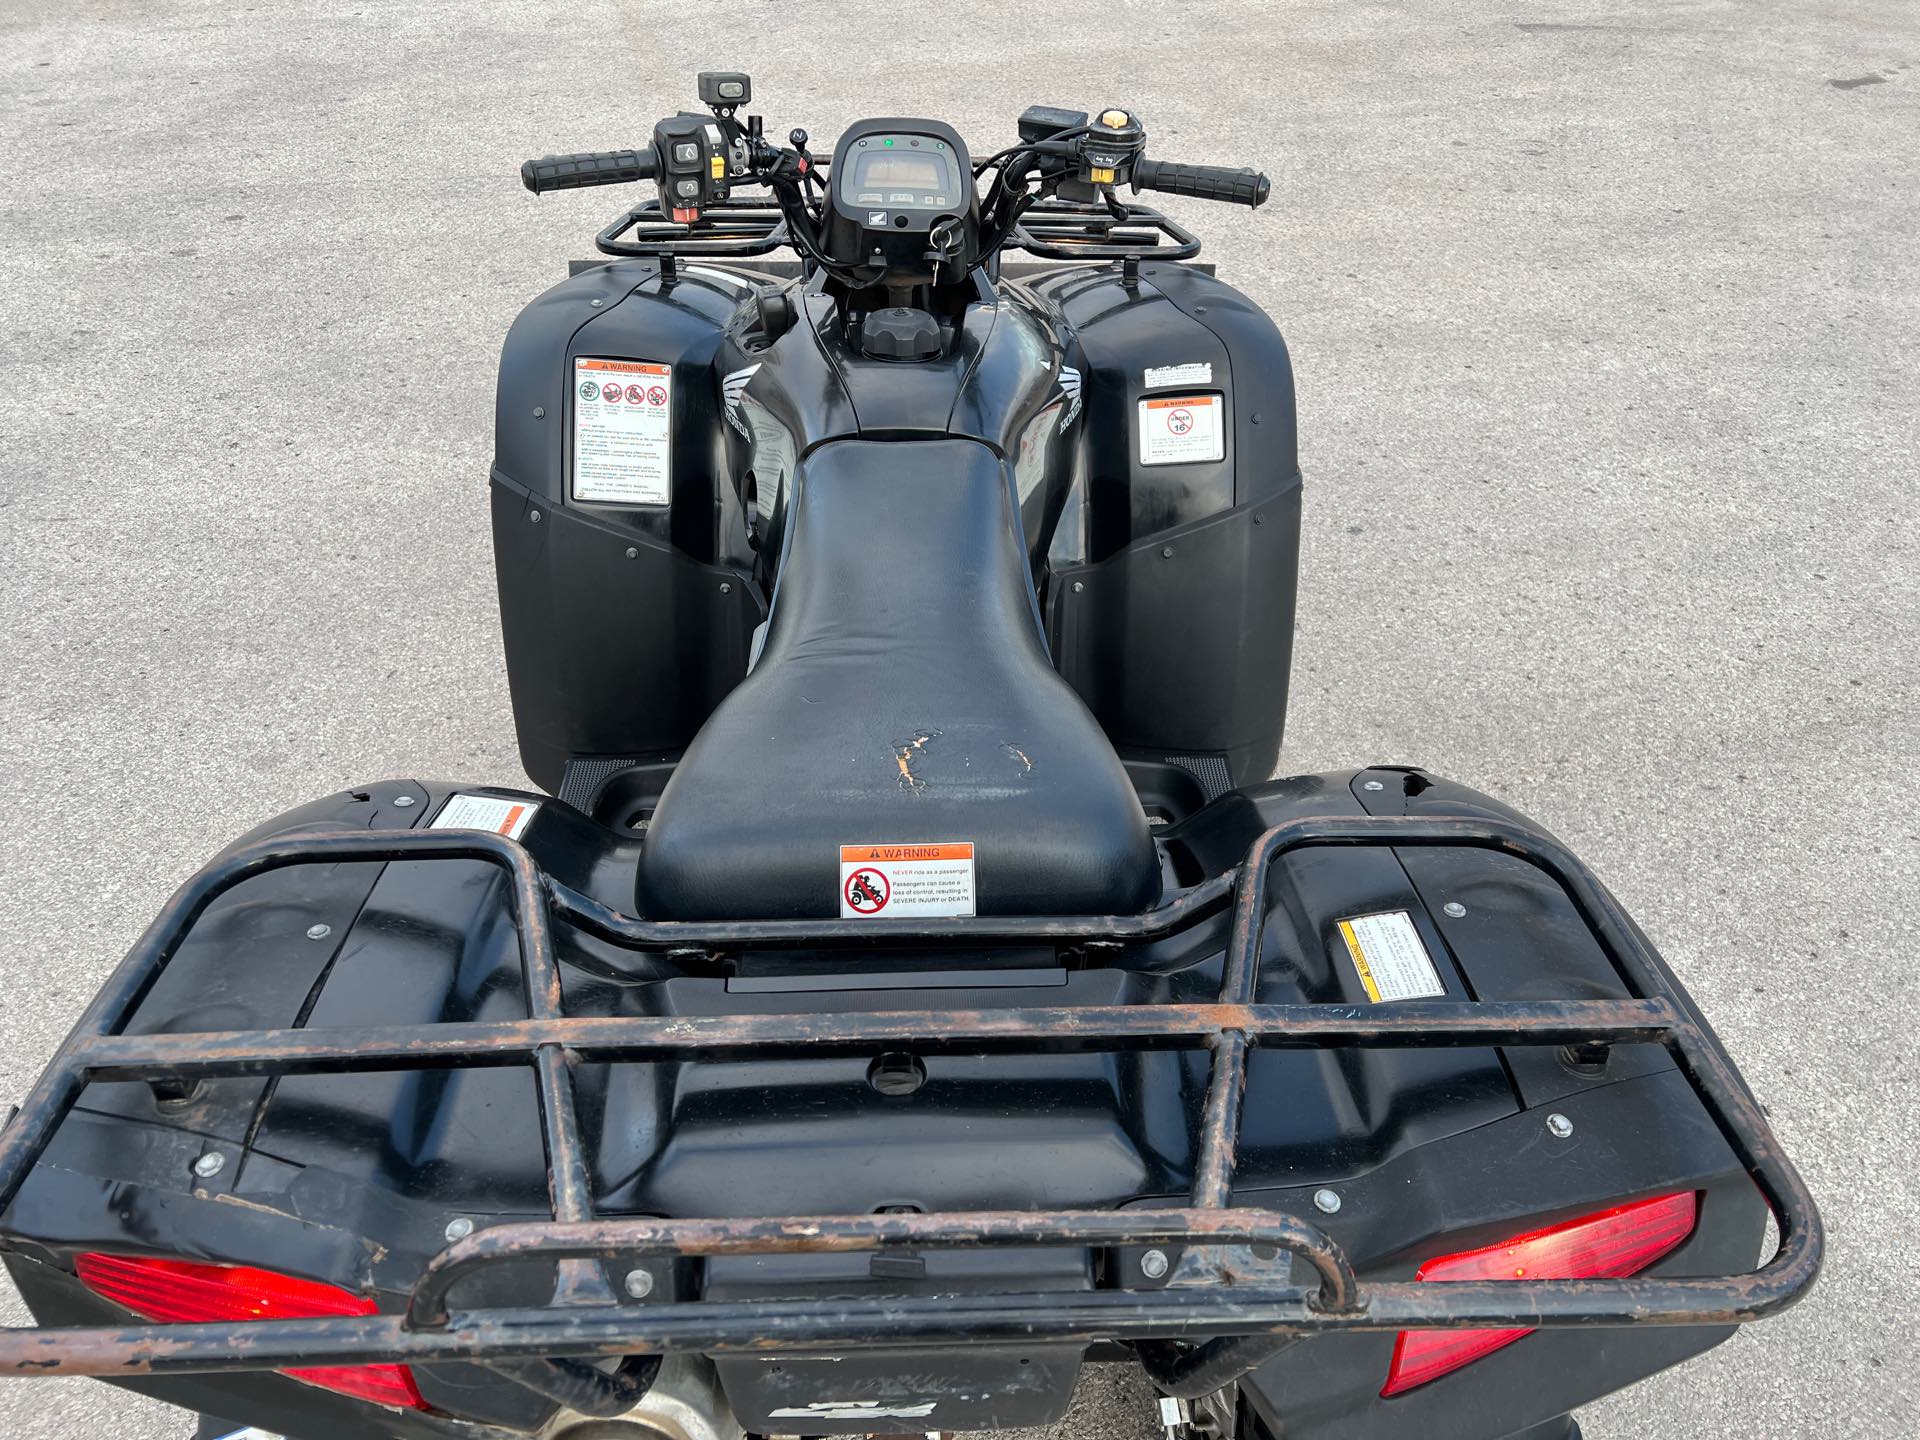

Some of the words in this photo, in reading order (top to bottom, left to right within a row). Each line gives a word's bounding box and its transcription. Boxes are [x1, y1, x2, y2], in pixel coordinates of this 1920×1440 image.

[610, 363, 647, 372] WARNING
[724, 406, 751, 443] HONDA
[1174, 424, 1186, 432] 16
[884, 848, 940, 858] WARNING
[1352, 944, 1367, 971] WARNING
